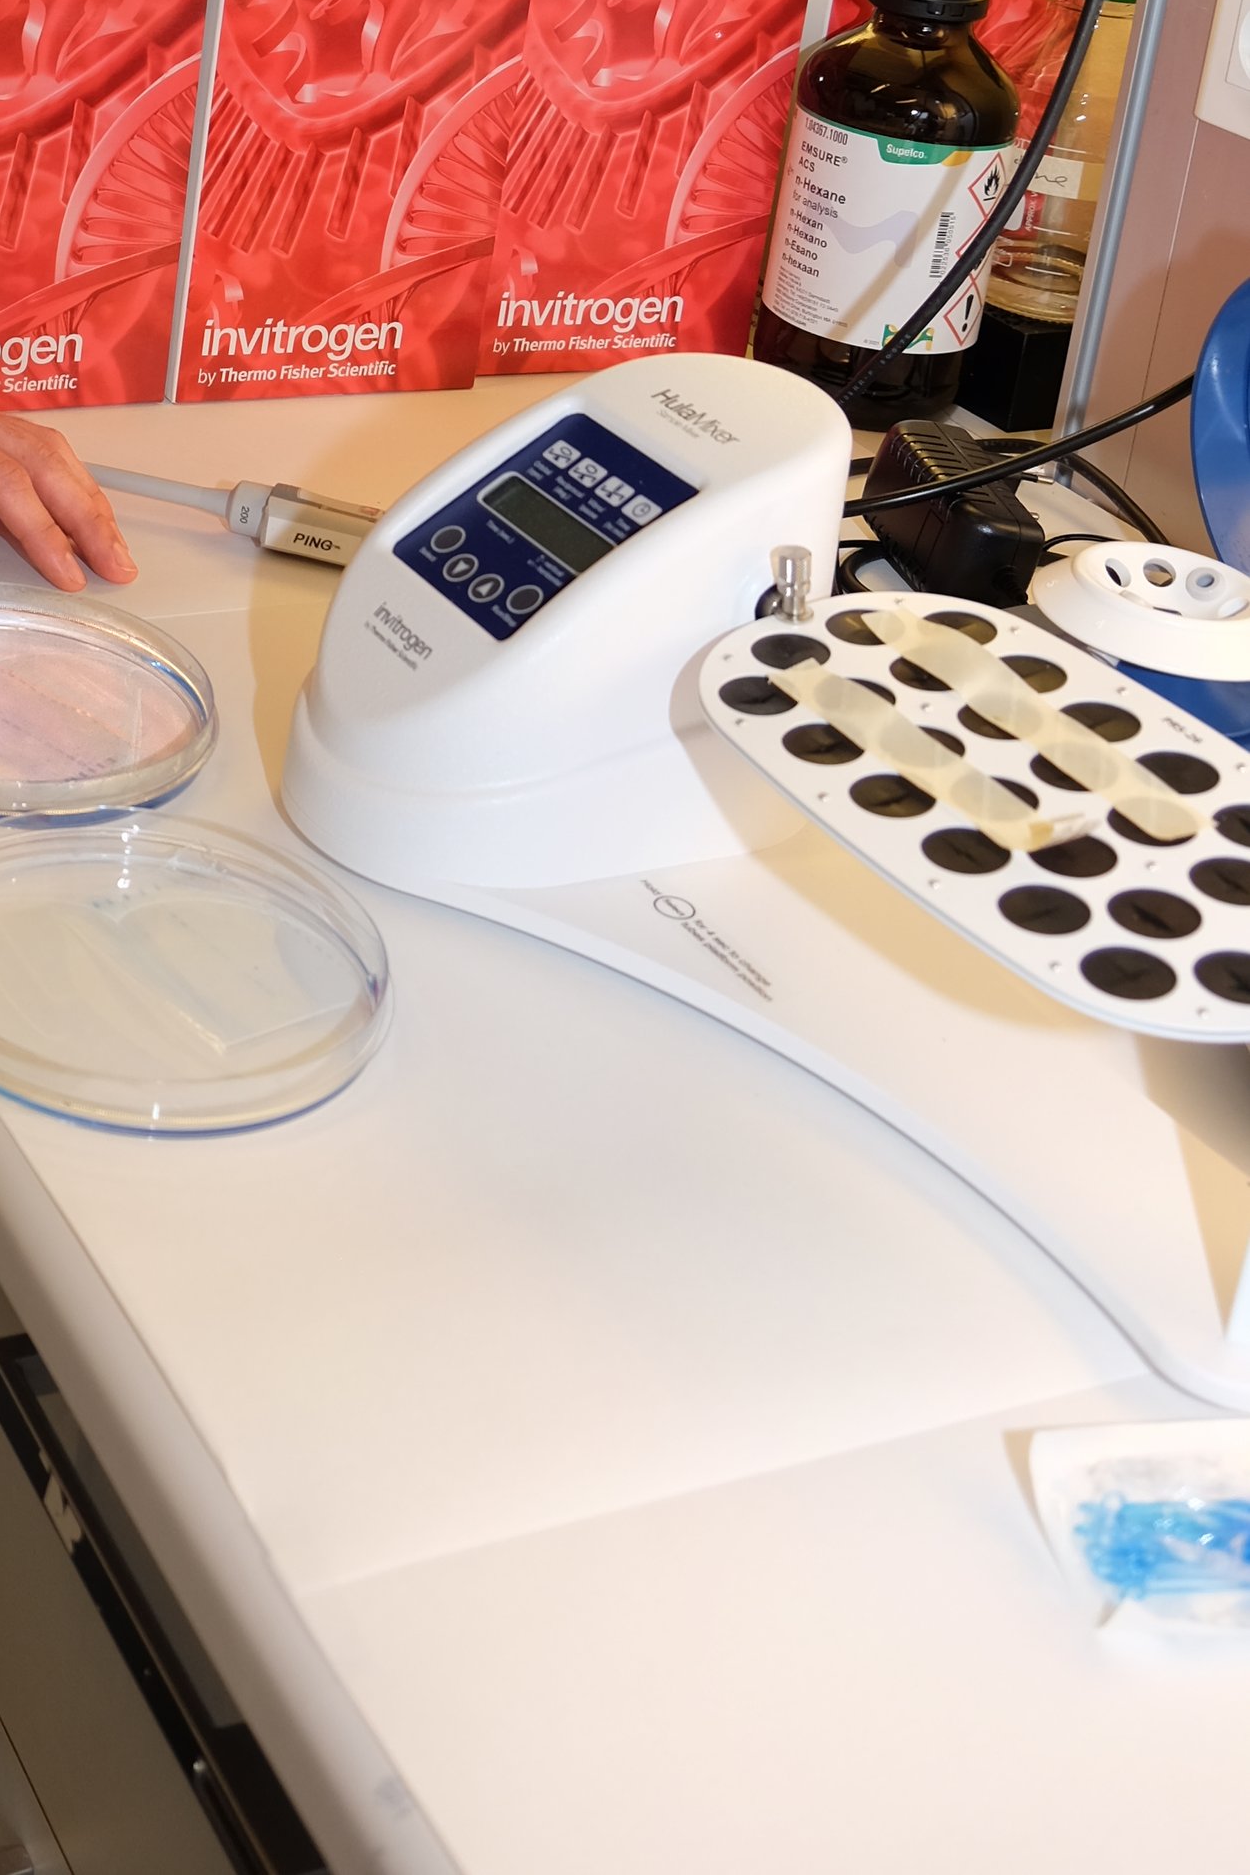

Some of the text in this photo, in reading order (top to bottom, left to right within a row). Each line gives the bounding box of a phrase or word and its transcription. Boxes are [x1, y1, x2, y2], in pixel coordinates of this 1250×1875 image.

[805, 117, 848, 145] 1.04367.1000
[798, 157, 815, 172] ACS
[795, 174, 846, 205] n-Hexane
[792, 189, 838, 219] for analysis
[790, 207, 824, 231] n-Hexan
[784, 237, 818, 261] n-Esano
[786, 222, 828, 249] n-Hexano
[781, 252, 820, 277] n-hexaan
[497, 291, 684, 334] invitrogen
[200, 318, 404, 361] invitrogen
[493, 333, 677, 356] by Thermo Fisher Scientific
[3, 374, 78, 394] Scientific
[197, 360, 397, 387] by Thermo Fisher Scientific
[651, 389, 740, 444] HulaMixer
[239, 506, 250, 524] 200
[374, 601, 433, 660] invitrogen
